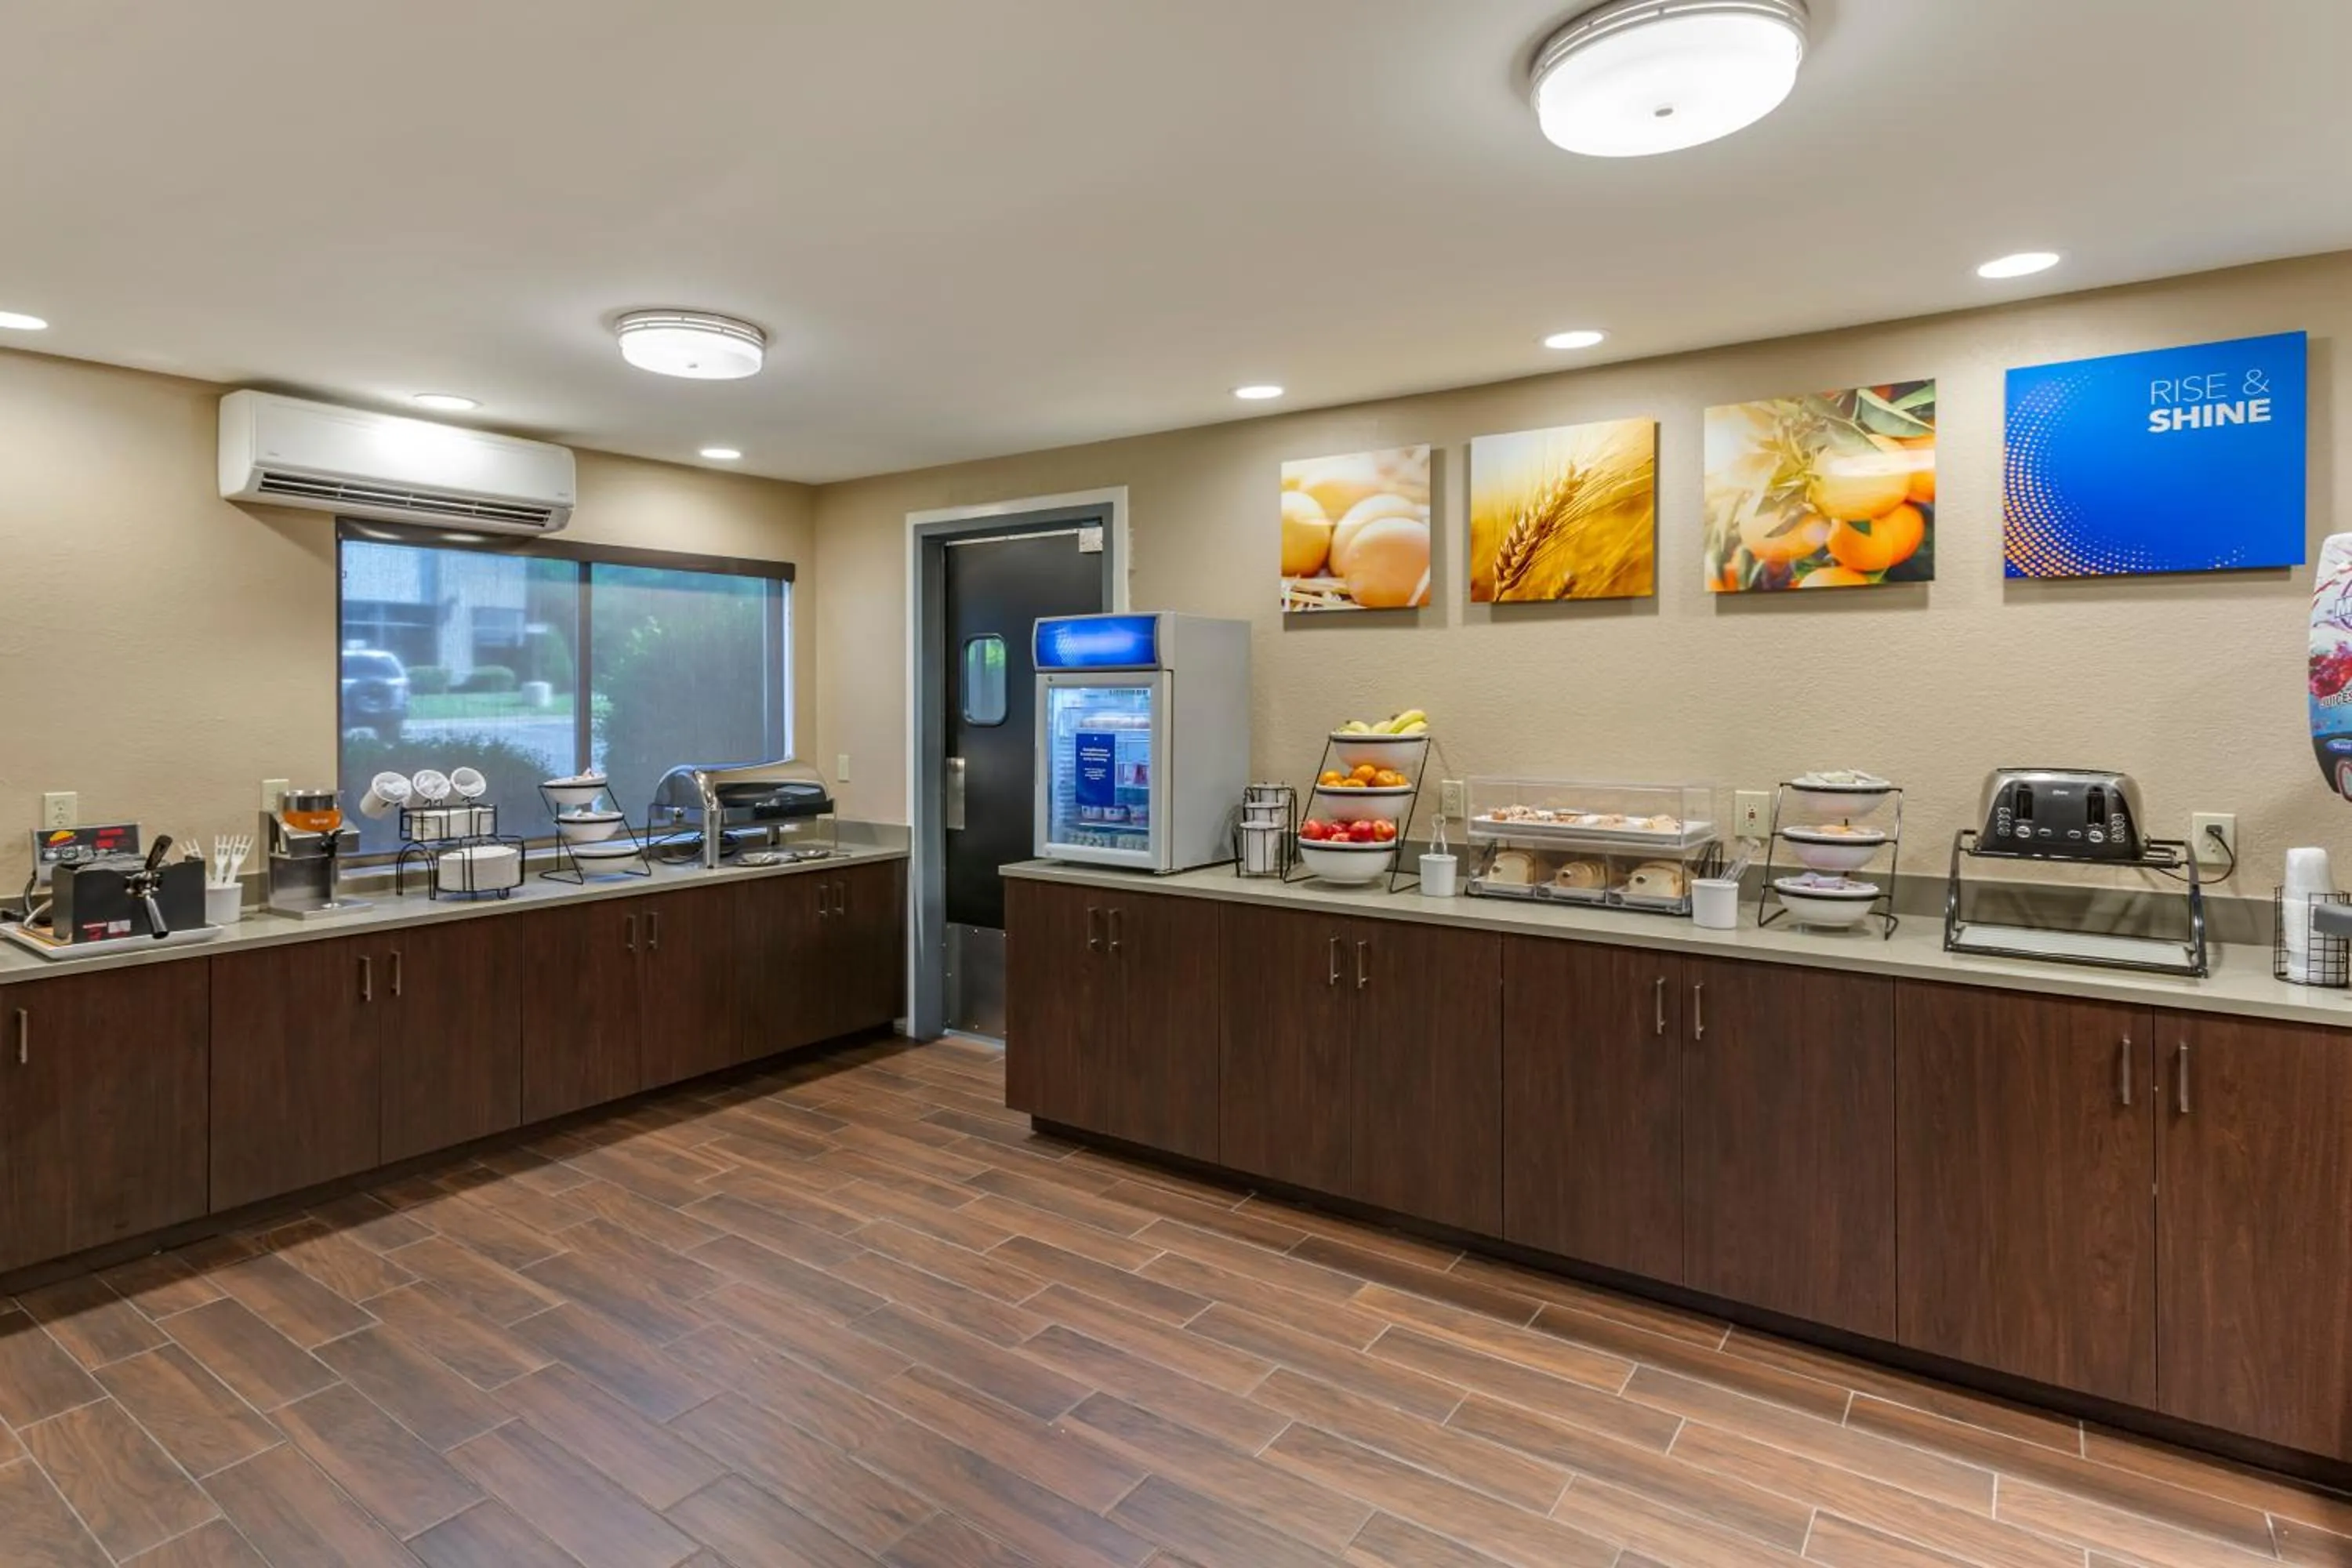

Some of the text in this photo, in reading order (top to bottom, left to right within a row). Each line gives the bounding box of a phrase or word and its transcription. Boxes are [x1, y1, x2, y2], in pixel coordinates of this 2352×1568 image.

[2151, 368, 2270, 405] RISE &
[2147, 397, 2271, 434] SHINE
